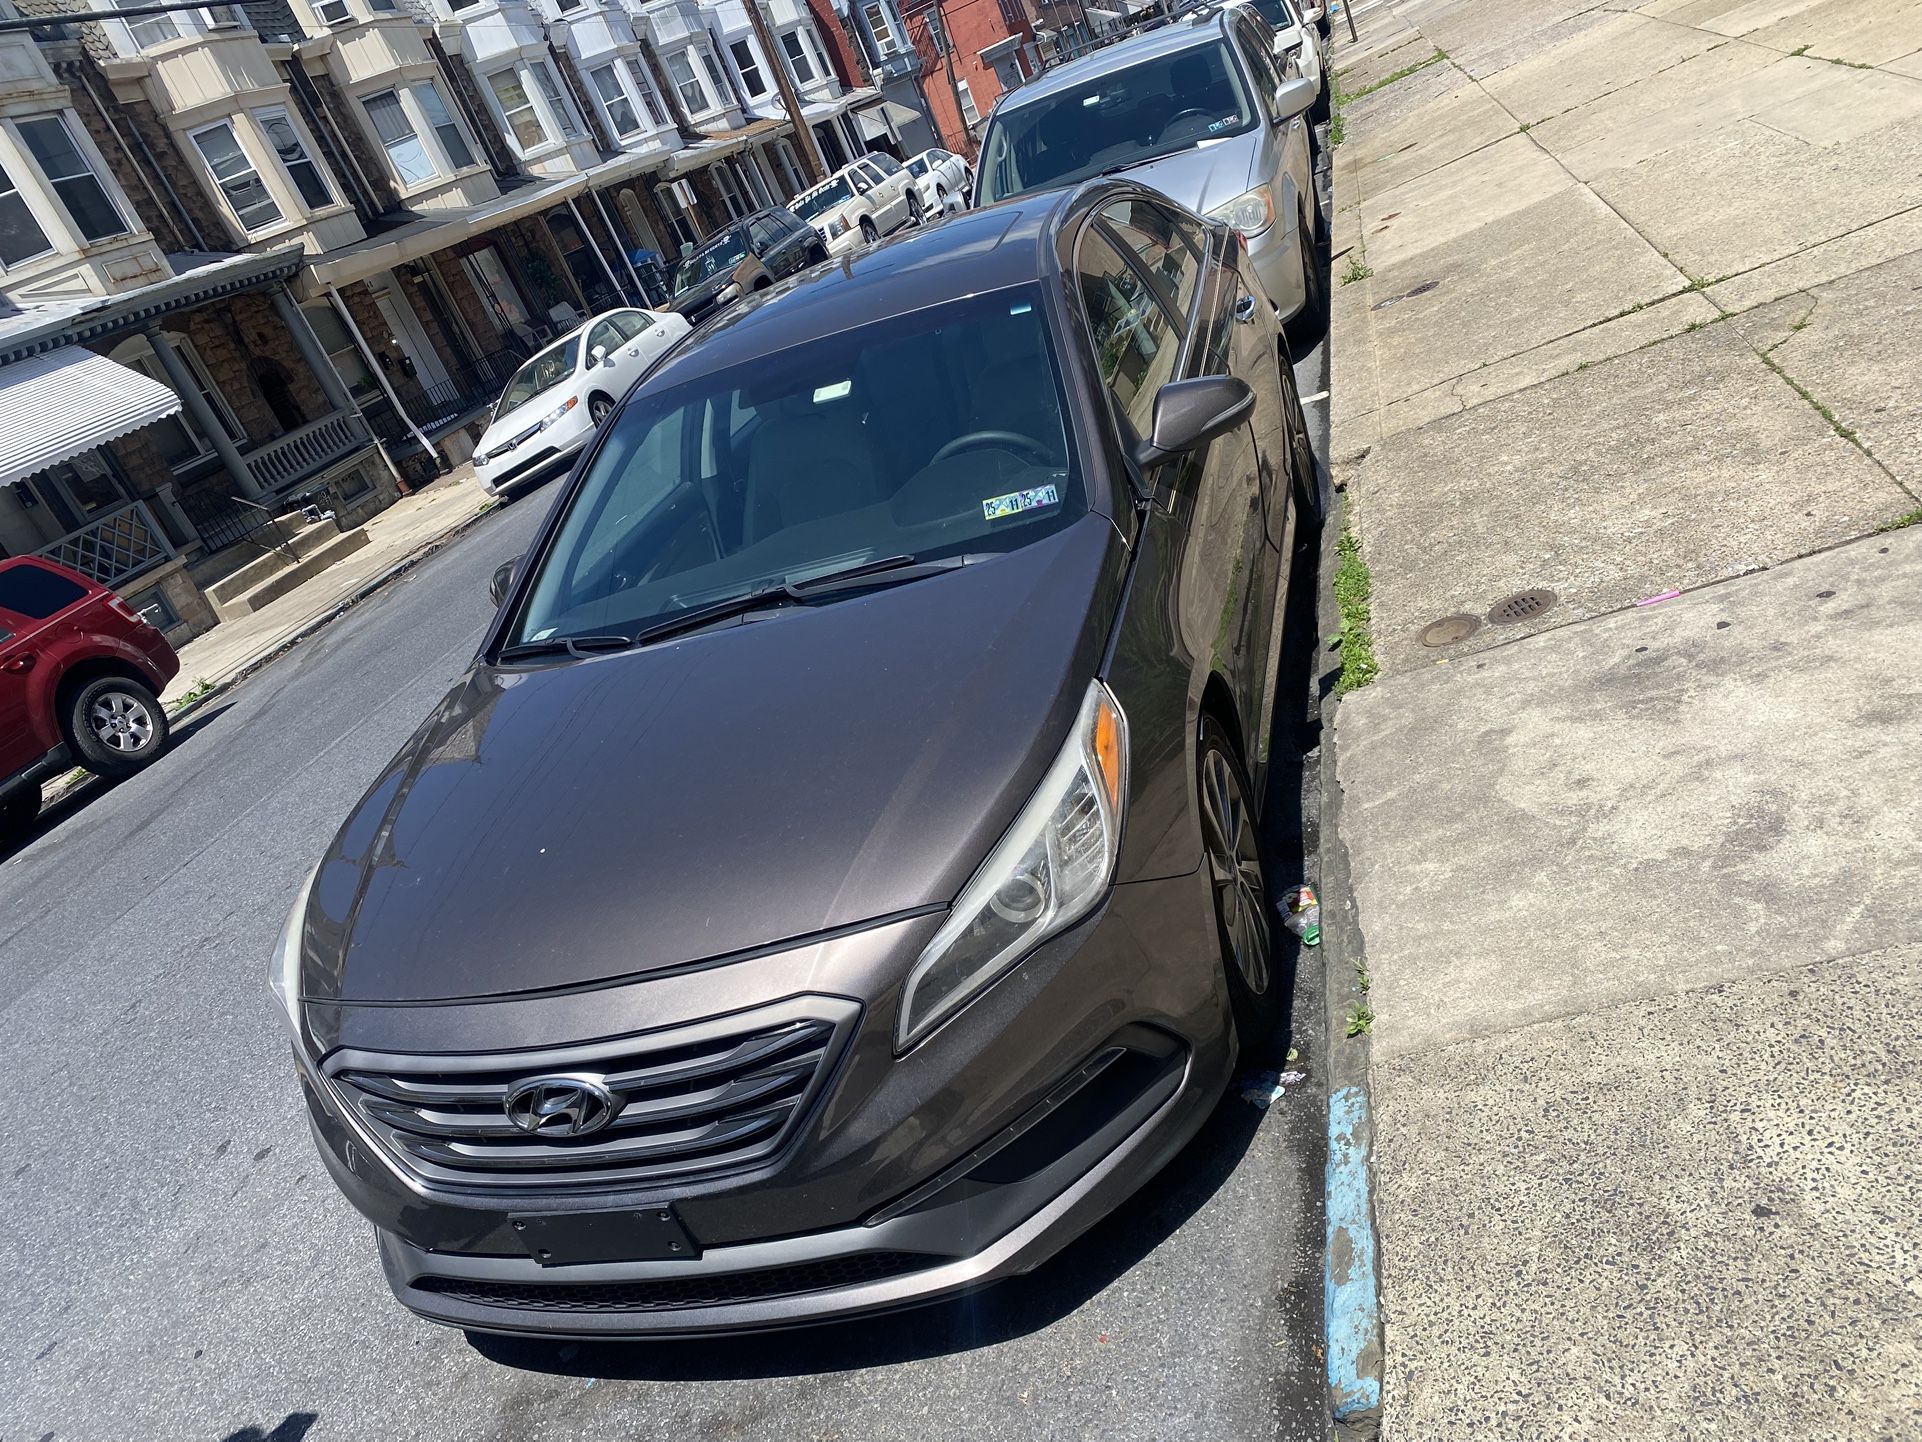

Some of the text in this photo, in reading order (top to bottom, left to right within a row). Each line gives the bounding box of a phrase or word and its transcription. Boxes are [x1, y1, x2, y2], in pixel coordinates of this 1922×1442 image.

[985, 489, 1056, 517] 25 11 25 11
